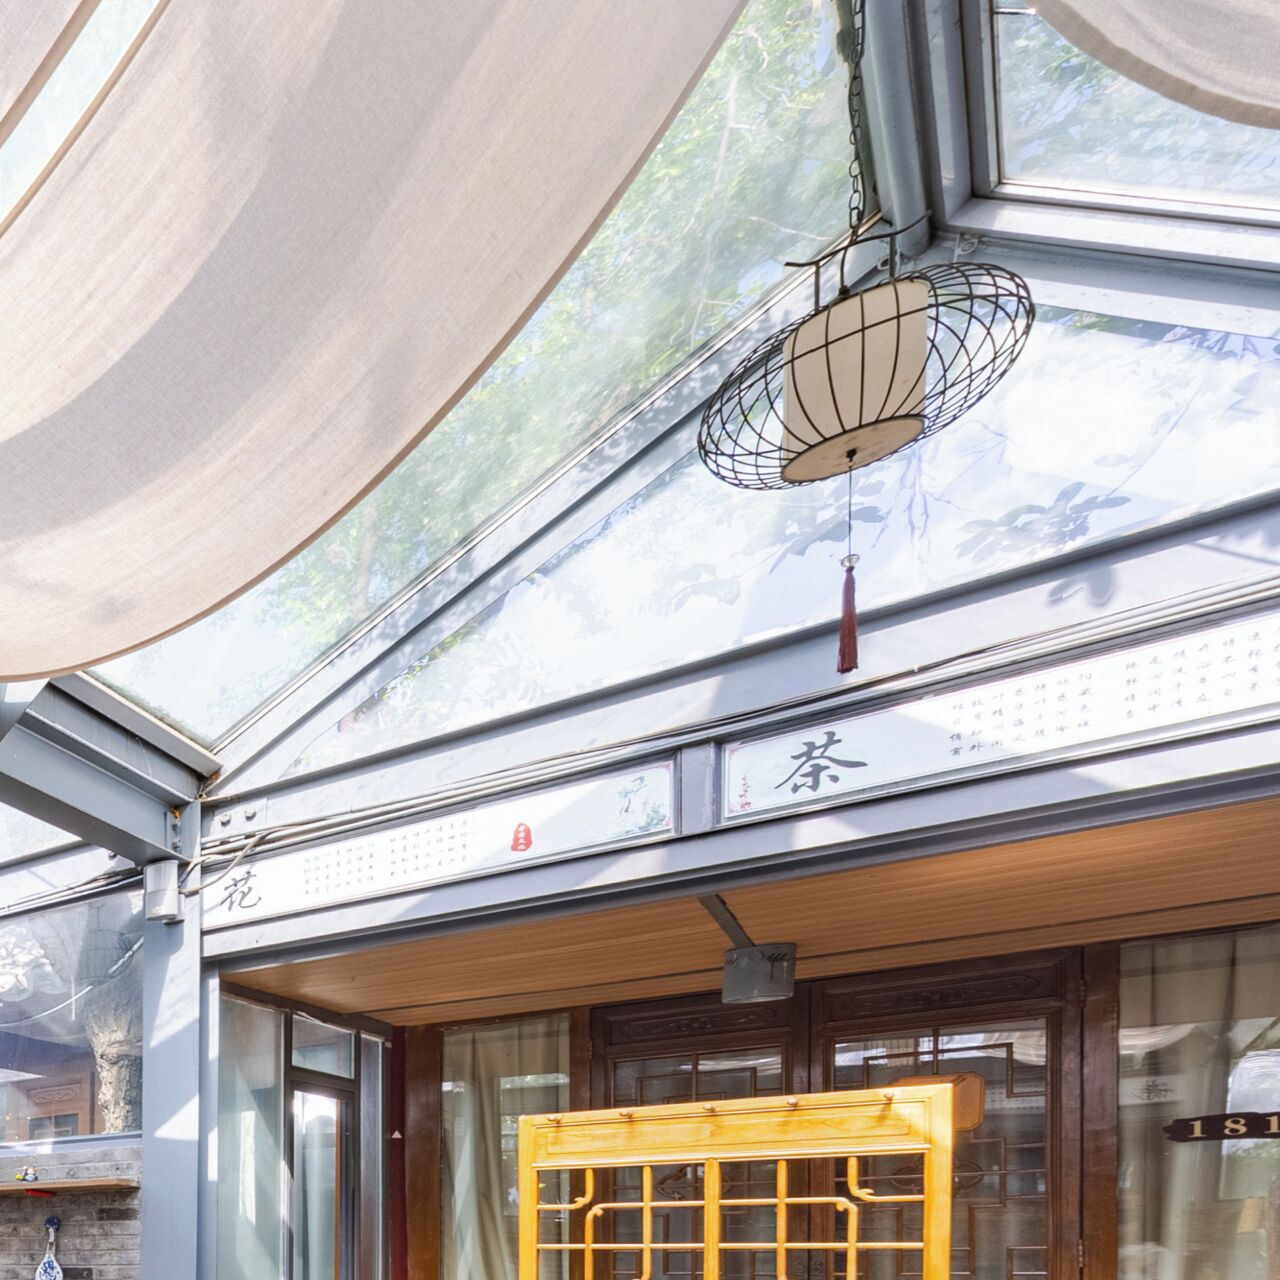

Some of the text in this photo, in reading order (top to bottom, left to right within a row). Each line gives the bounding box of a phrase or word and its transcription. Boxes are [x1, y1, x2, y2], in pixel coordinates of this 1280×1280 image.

[774, 730, 868, 794] 茶
[219, 870, 262, 912] 花
[1187, 1114, 1280, 1138] 181
